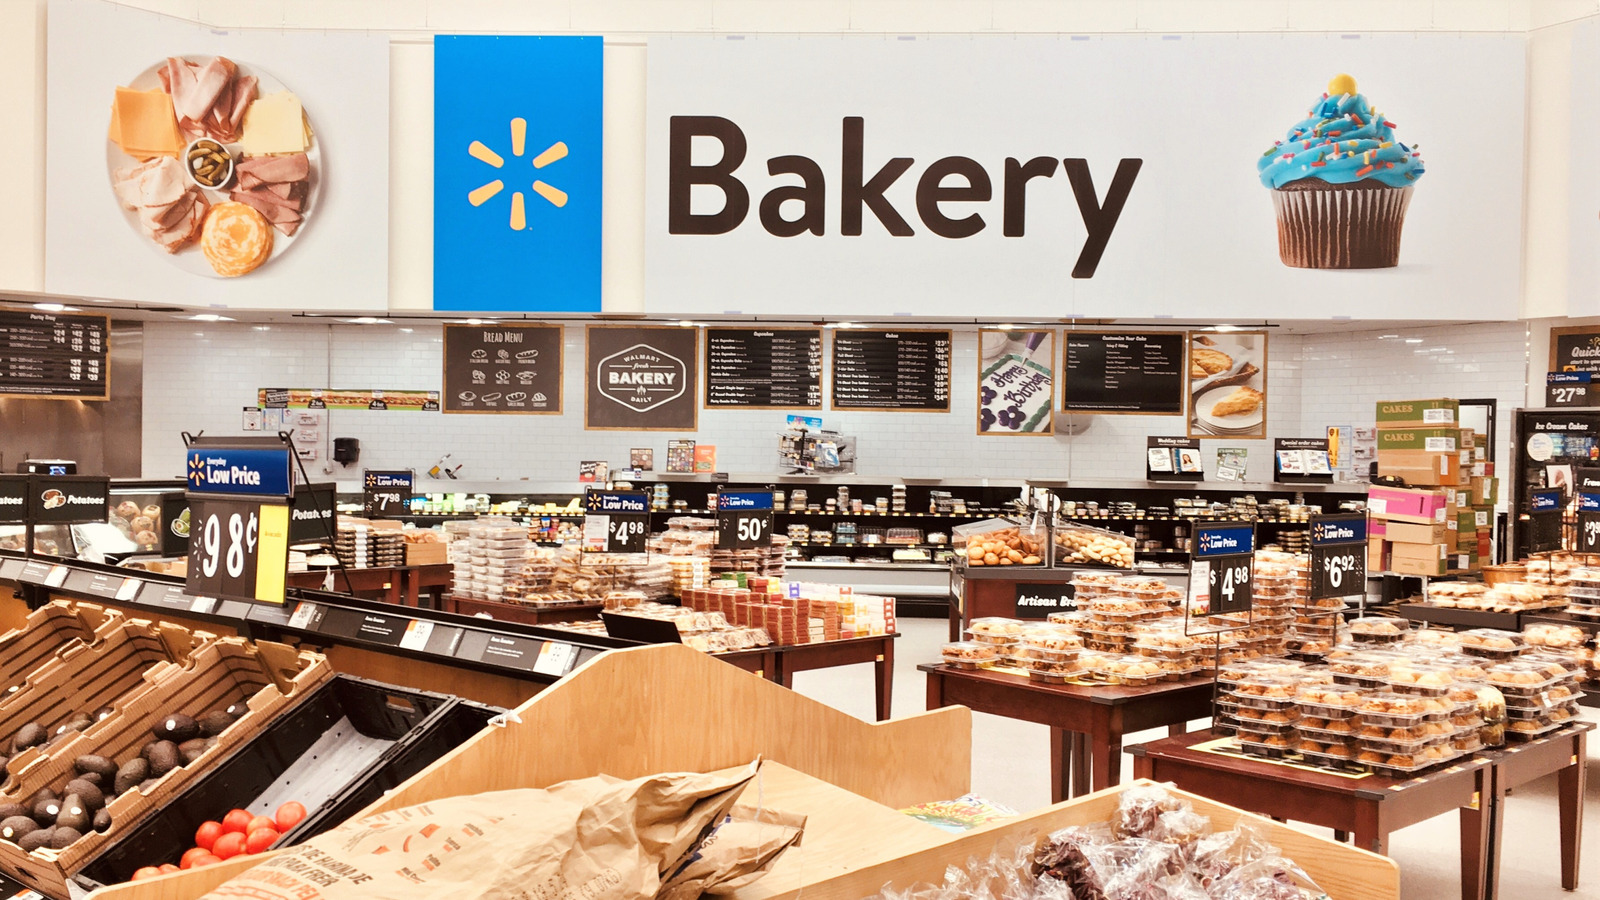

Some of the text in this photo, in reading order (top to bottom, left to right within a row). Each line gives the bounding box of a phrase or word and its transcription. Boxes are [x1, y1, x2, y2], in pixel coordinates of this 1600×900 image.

[669, 115, 1143, 278] Bakery
[484, 332, 523, 343] BREAD MENU
[609, 372, 676, 385] BAKERY
[1383, 405, 1413, 413] CAKES
[1535, 422, 1588, 430] Ice Cream Cakes
[1384, 433, 1415, 442] CAKES
[207, 465, 260, 486] Low Price
[0, 497, 23, 505] atoes
[67, 495, 104, 504] Potatoes
[603, 500, 644, 511] Low Price
[1325, 528, 1354, 539] Low Price
[1211, 538, 1237, 548] Low Price
[1018, 595, 1057, 606] Artisan
